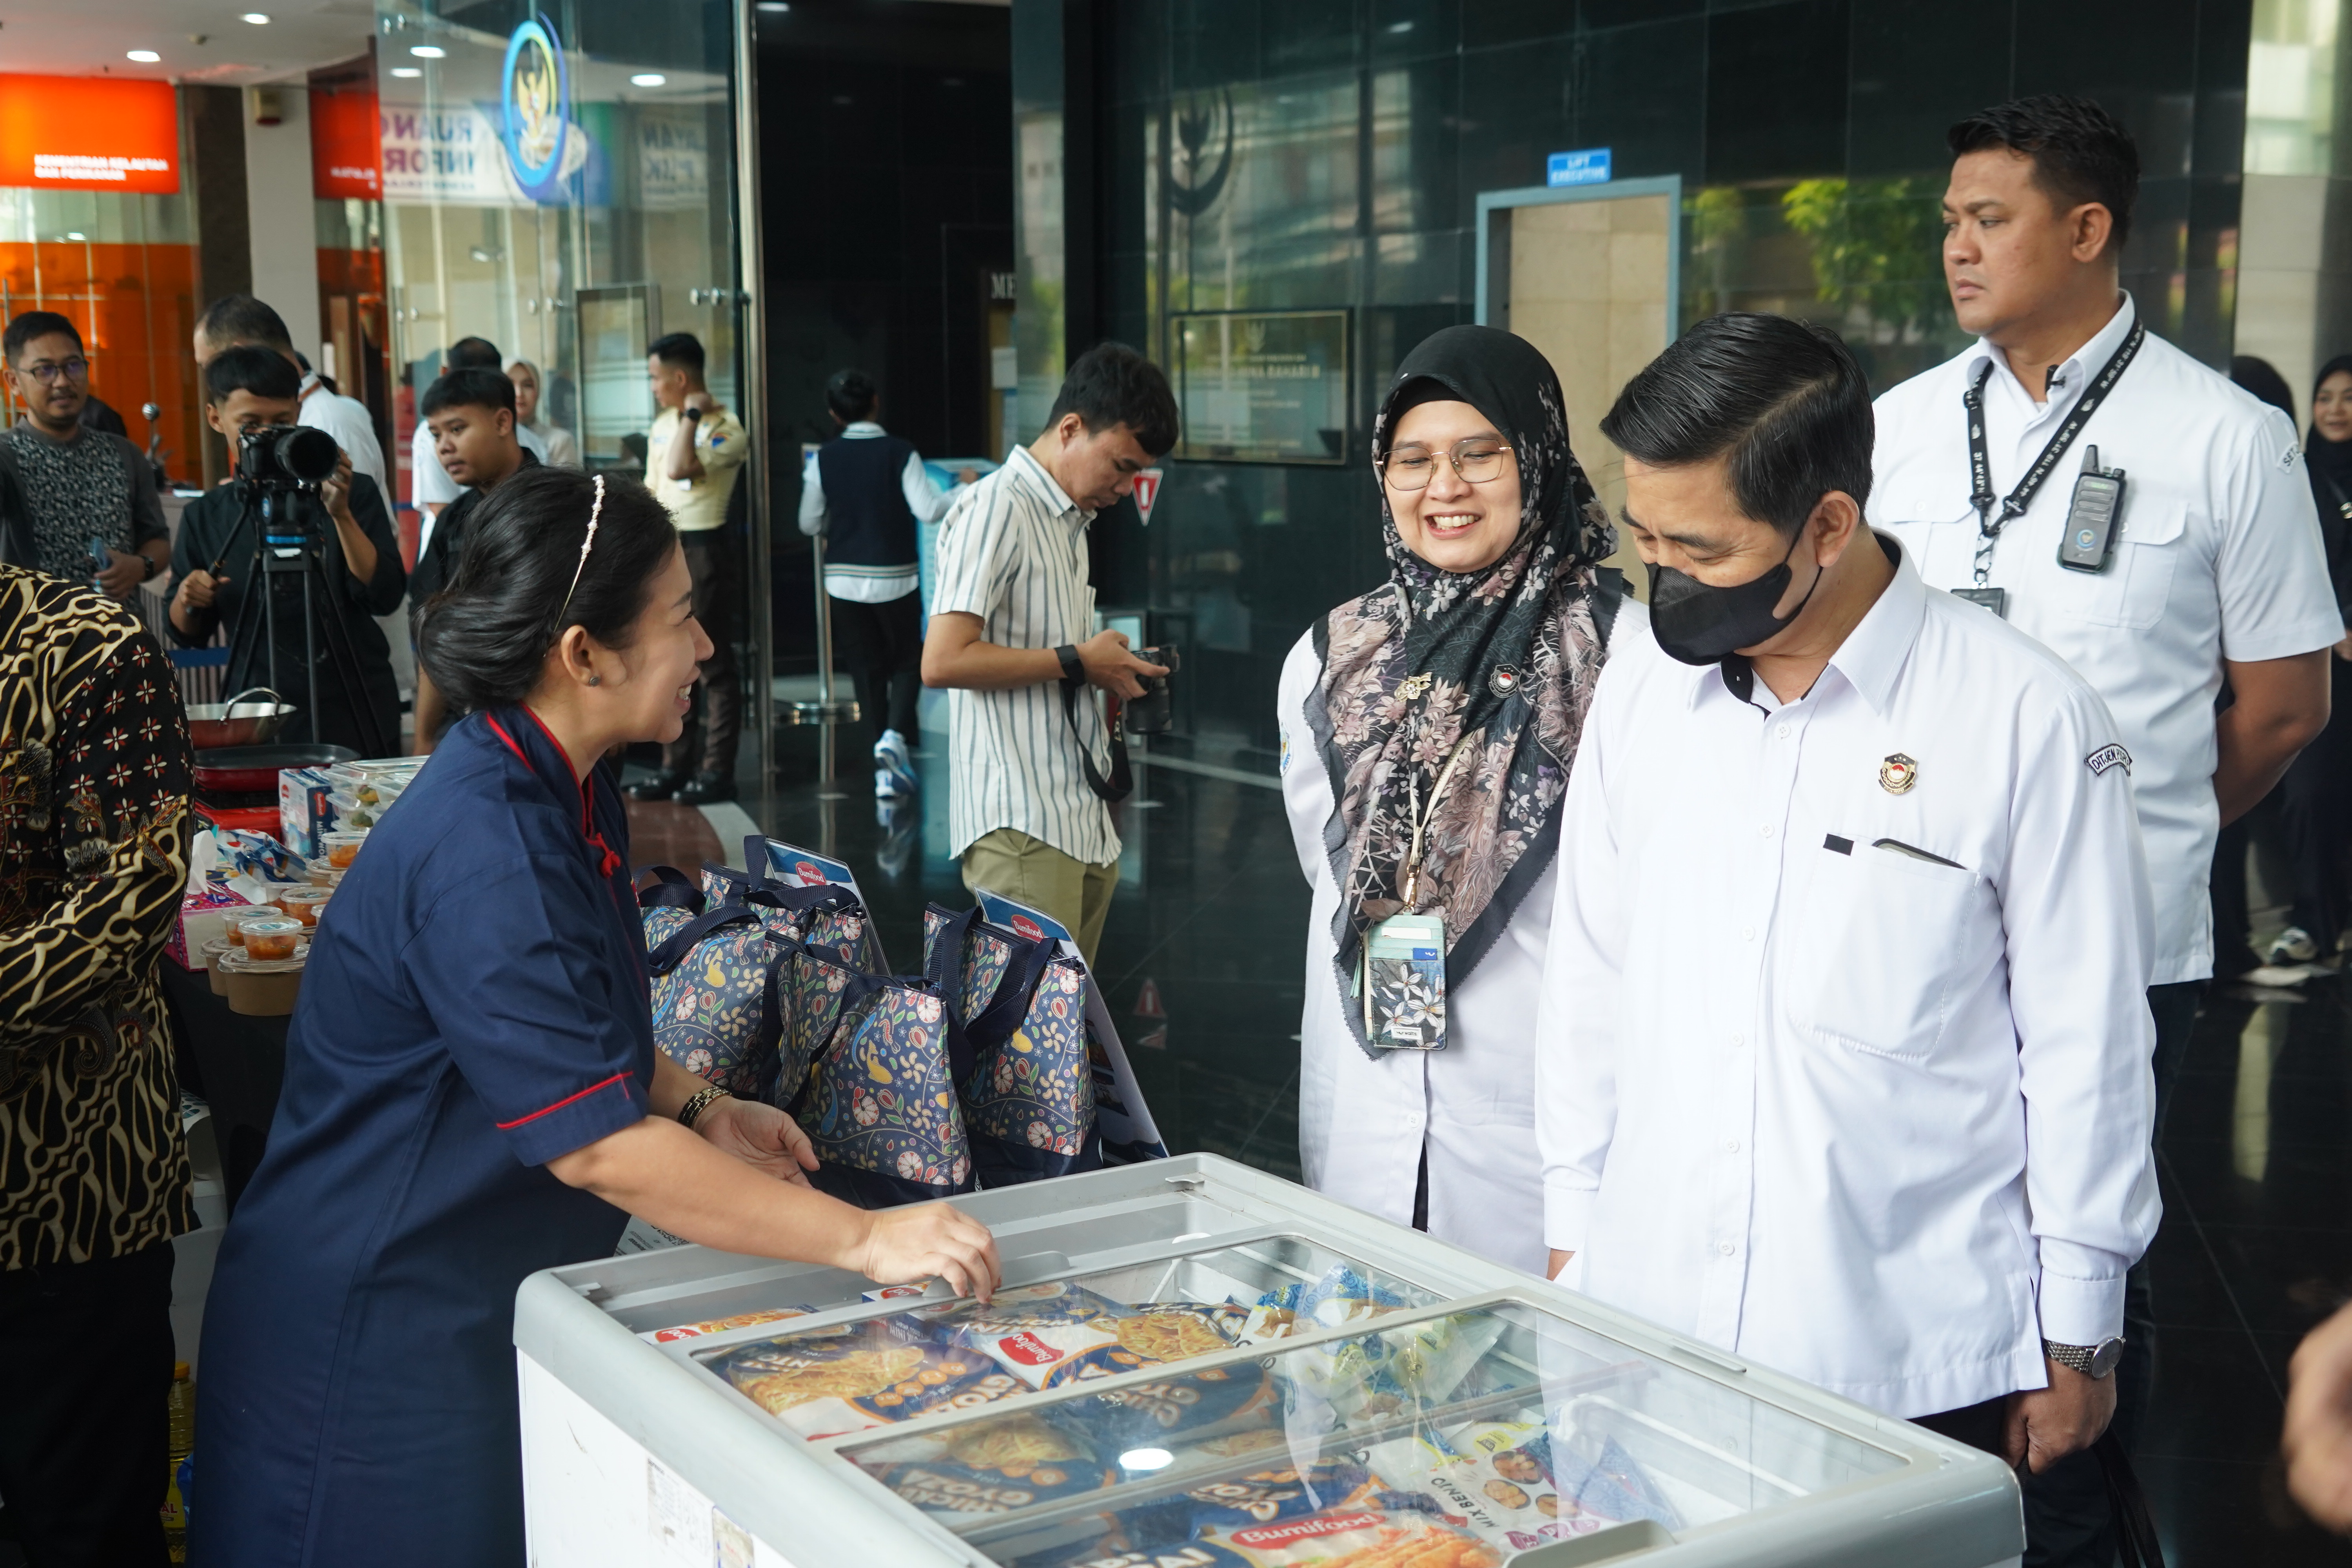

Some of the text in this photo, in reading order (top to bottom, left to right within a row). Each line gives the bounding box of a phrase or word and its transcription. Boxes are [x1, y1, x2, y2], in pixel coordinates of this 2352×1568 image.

[2092, 747, 2117, 770] DITJEN
[798, 867, 825, 883] Bumifood
[1013, 920, 1044, 939] Bumifood
[889, 1324, 906, 1342] MINI
[1012, 1333, 1053, 1363] Bumifoo
[1431, 1477, 1500, 1528] MIX BENTO
[1240, 1513, 1379, 1543] Bumifood
